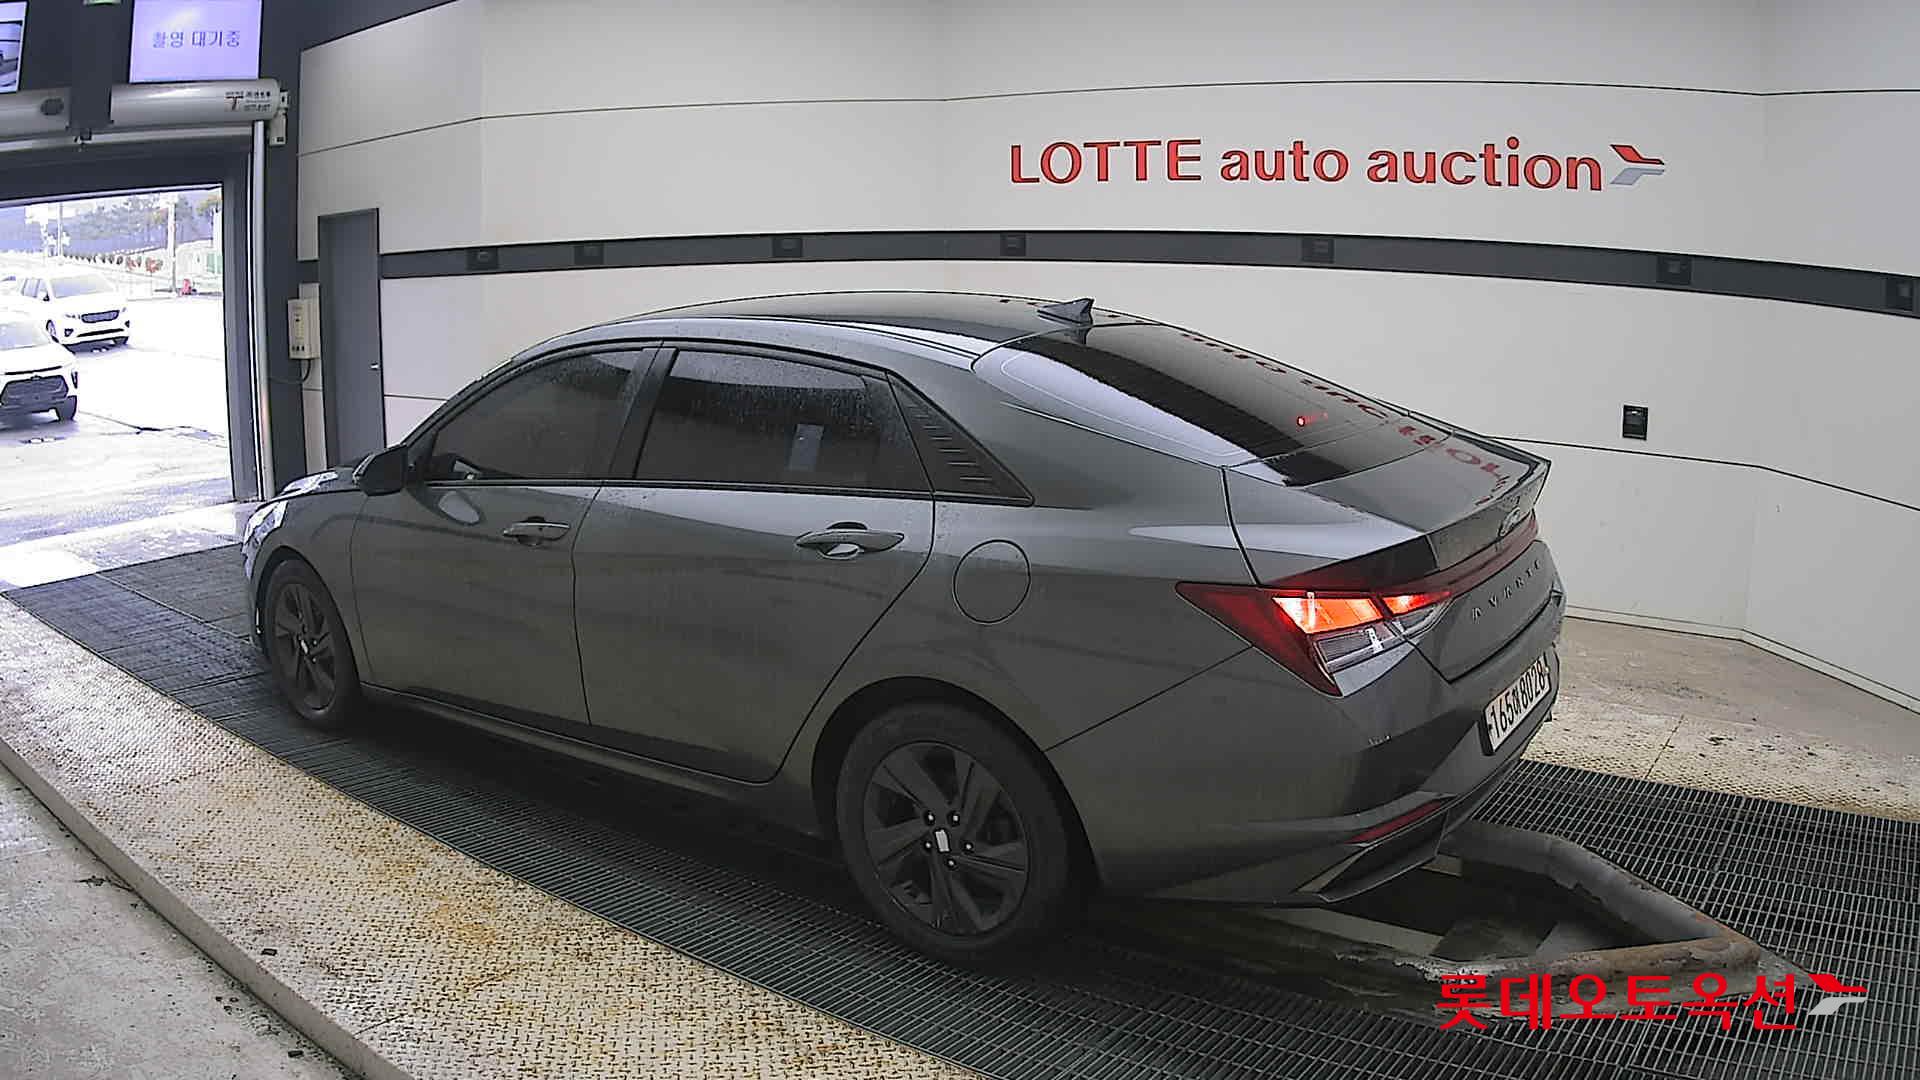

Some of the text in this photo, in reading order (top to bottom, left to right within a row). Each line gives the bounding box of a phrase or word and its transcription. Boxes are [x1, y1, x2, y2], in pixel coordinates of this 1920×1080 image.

[191, 30, 241, 48] 대기중
[1011, 137, 1603, 191] LOTTE auto auction
